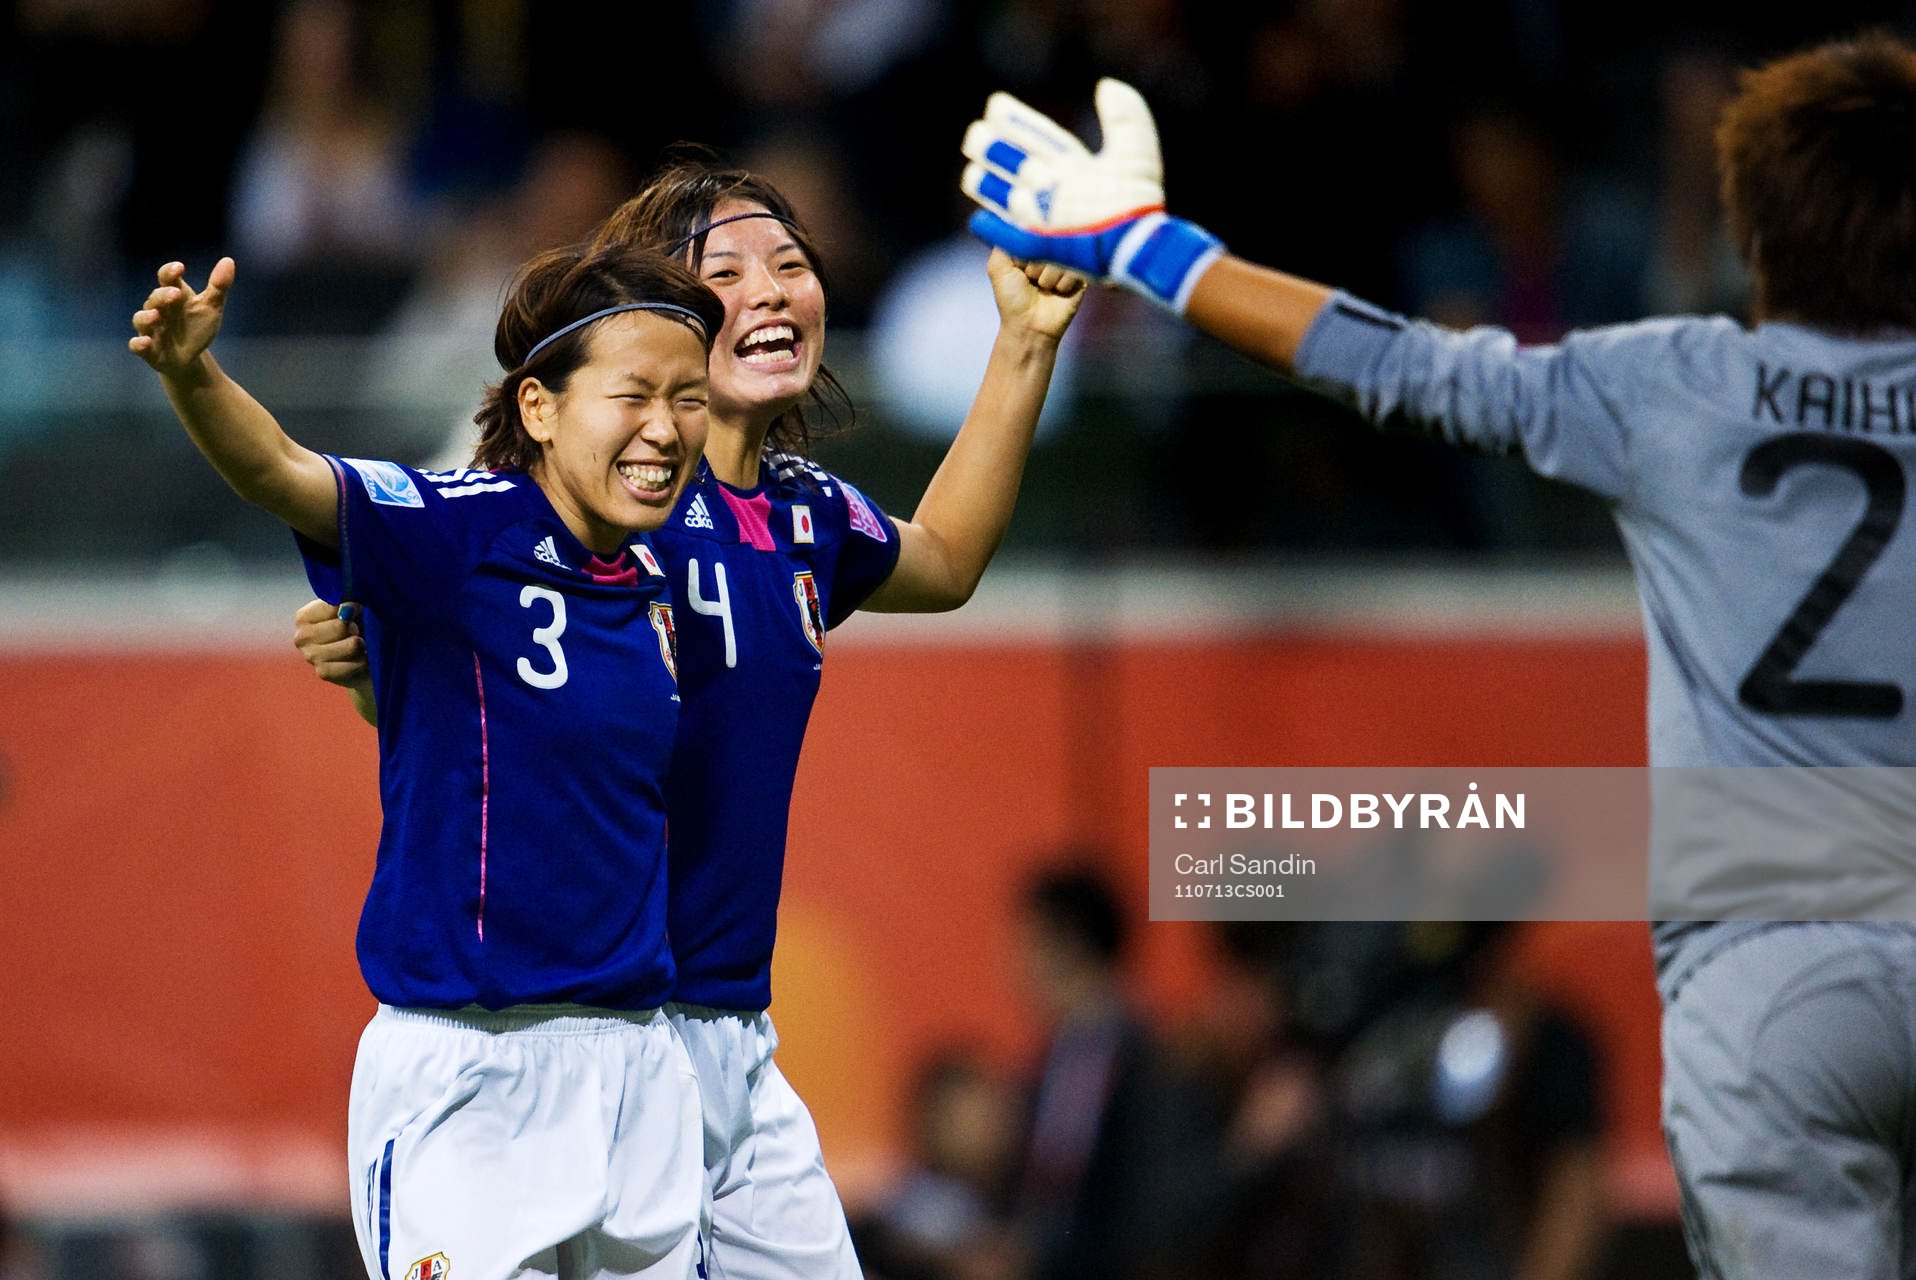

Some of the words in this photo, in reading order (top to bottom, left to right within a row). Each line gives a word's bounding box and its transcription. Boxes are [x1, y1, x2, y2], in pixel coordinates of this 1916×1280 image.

[1753, 360, 1916, 433] KAIH
[687, 557, 738, 669] 4
[1738, 432, 1907, 719] 2
[516, 585, 568, 690] 3
